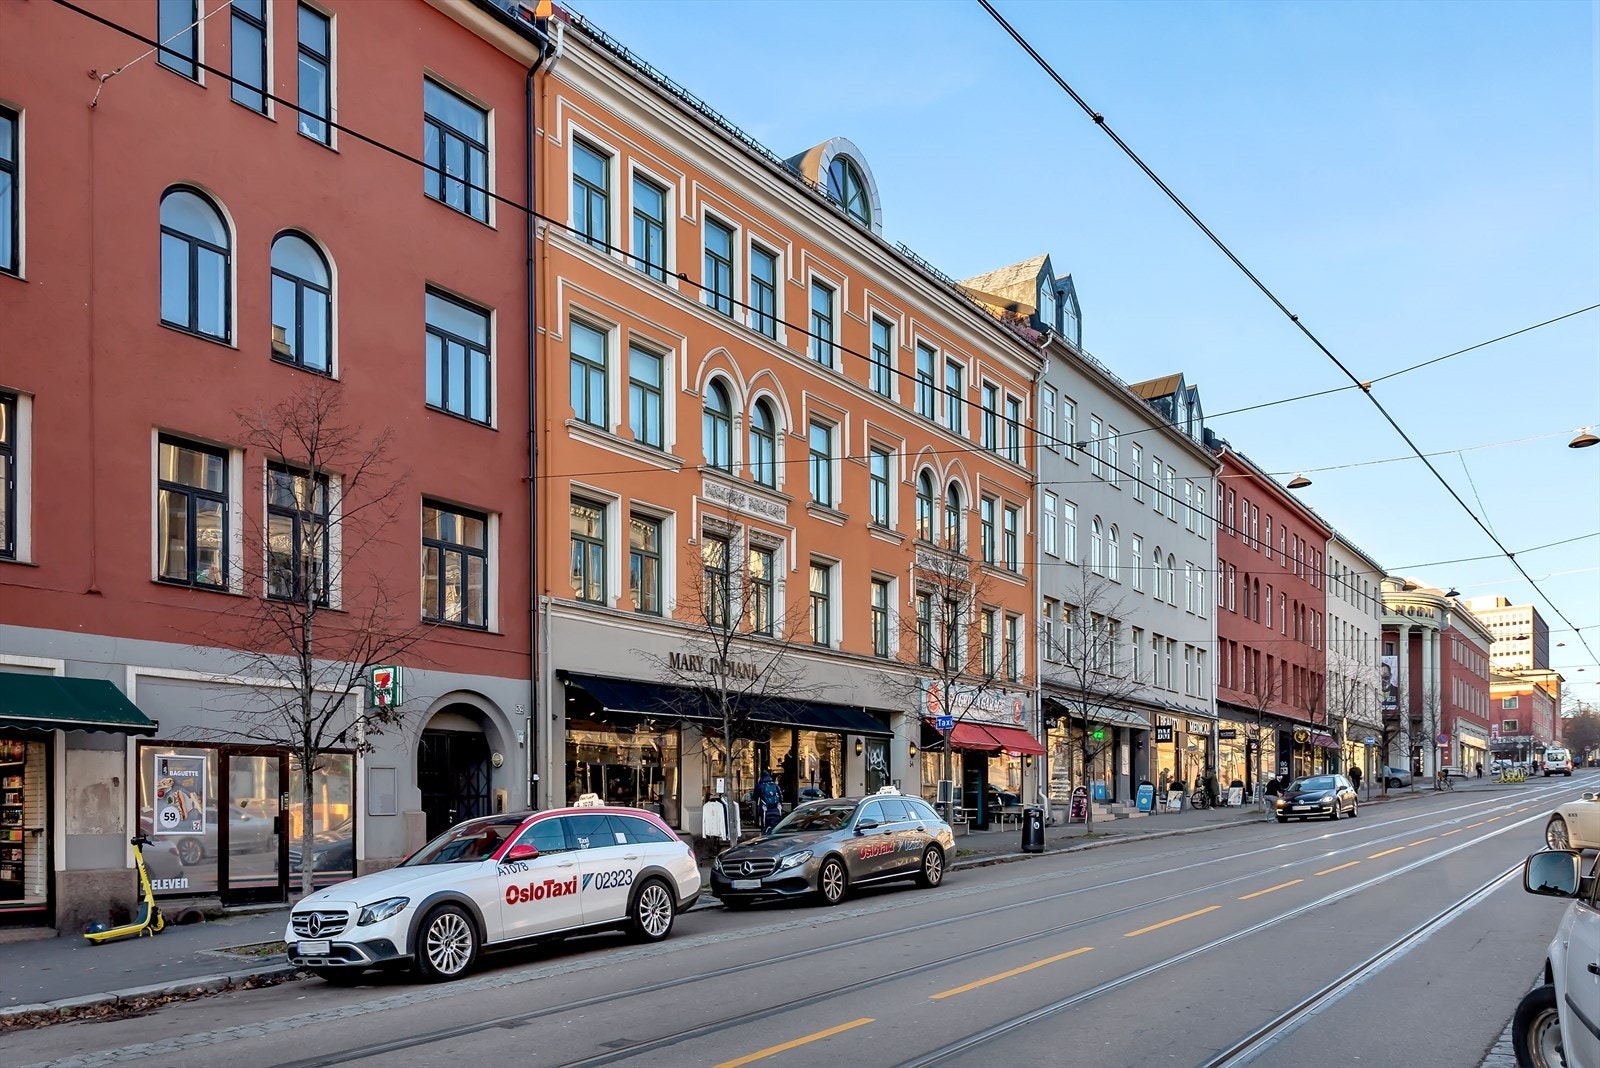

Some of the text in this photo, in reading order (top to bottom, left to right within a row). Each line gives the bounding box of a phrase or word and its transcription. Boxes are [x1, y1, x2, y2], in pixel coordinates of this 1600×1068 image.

[669, 652, 703, 672] MARY
[937, 718, 953, 728] Taxi
[1157, 728, 1170, 740] BM
[498, 862, 529, 876] A1078
[506, 869, 633, 905] OsloTaxi 02323
